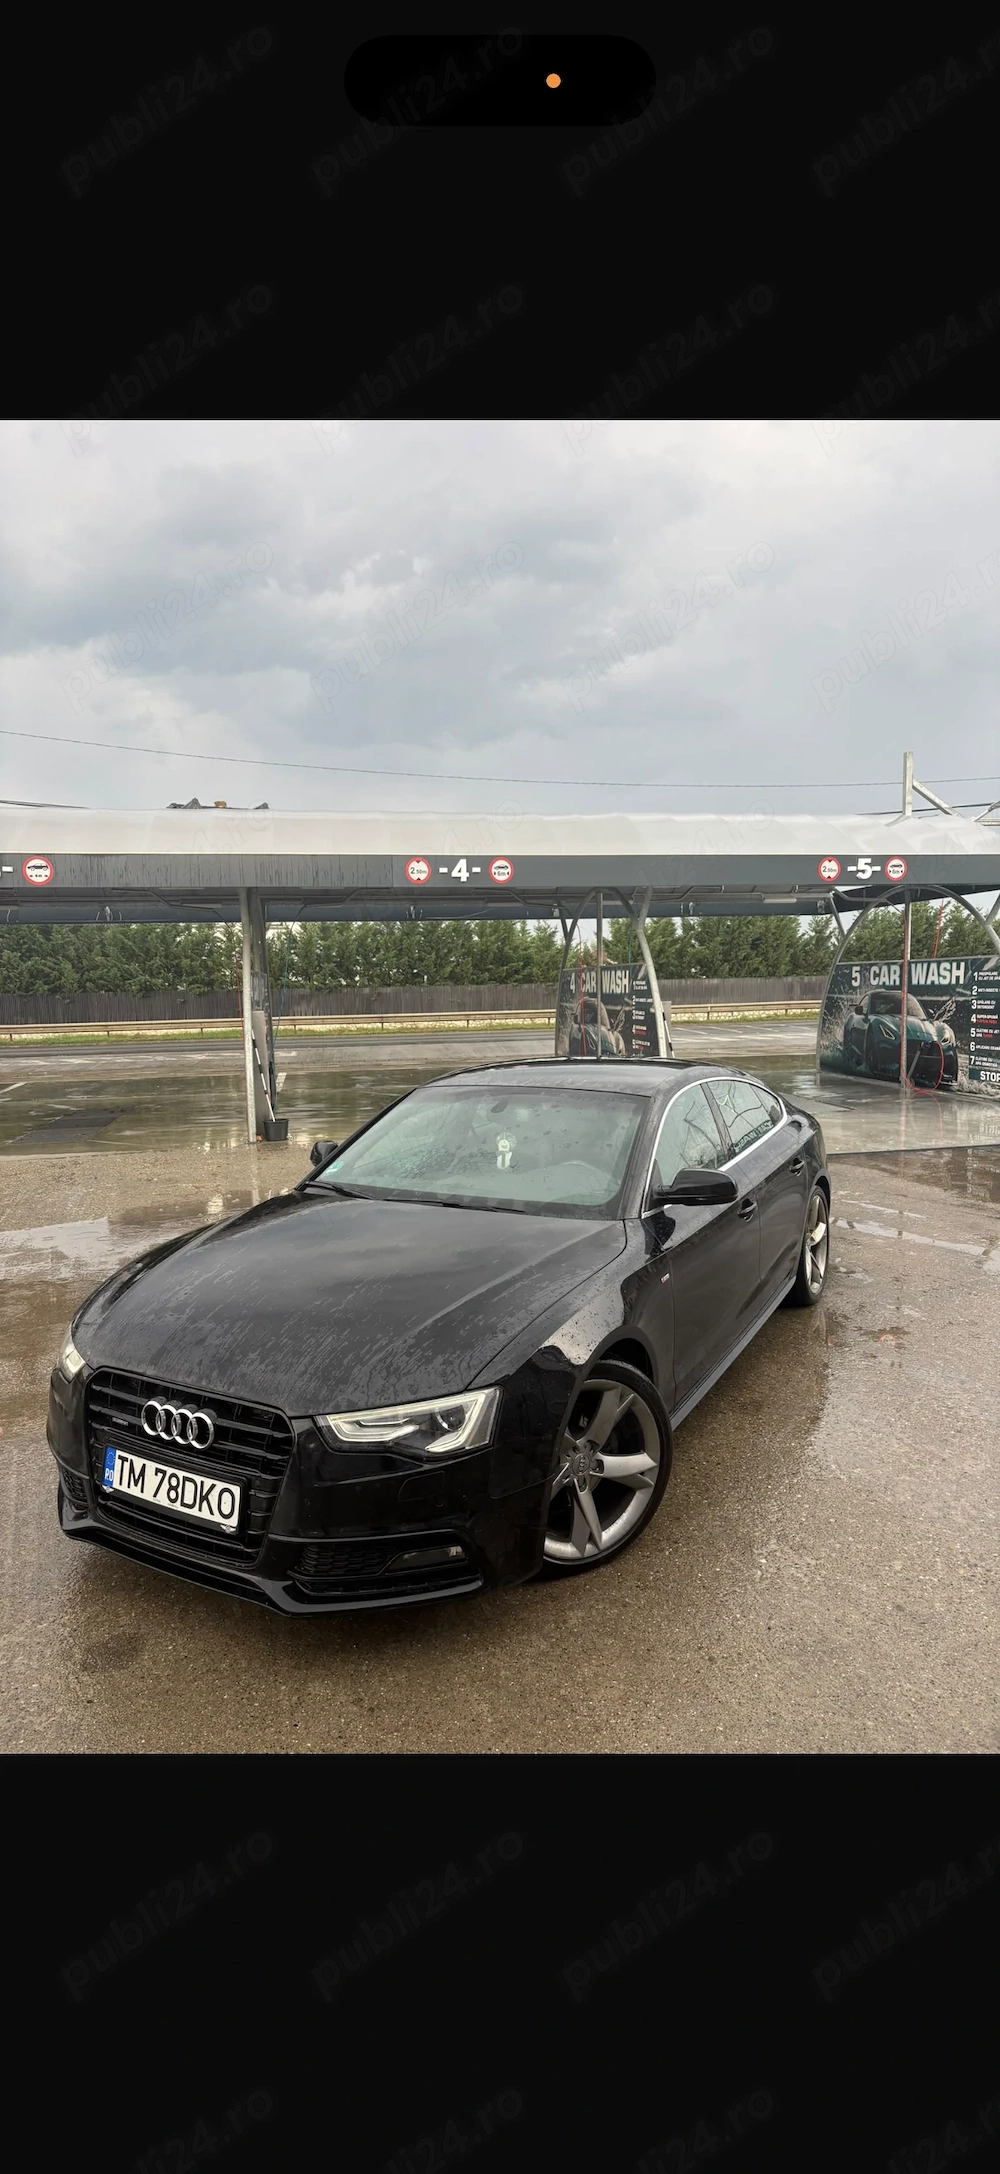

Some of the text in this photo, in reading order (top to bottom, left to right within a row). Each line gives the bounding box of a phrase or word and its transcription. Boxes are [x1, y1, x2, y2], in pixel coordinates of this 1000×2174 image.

[851, 962, 965, 987] 5 CAR WASH
[973, 971, 978, 981] 1
[570, 972, 575, 994] 4
[579, 971, 597, 993] CAR
[602, 970, 629, 994] WASH
[972, 985, 977, 995] 2
[971, 1000, 976, 1009] 3
[971, 1014, 976, 1023] 4
[970, 1028, 975, 1037] 5
[970, 1041, 975, 1051] 6
[970, 1056, 975, 1065] 7
[105, 1468, 114, 1482] RO
[117, 1454, 236, 1520] TM 78DKO
